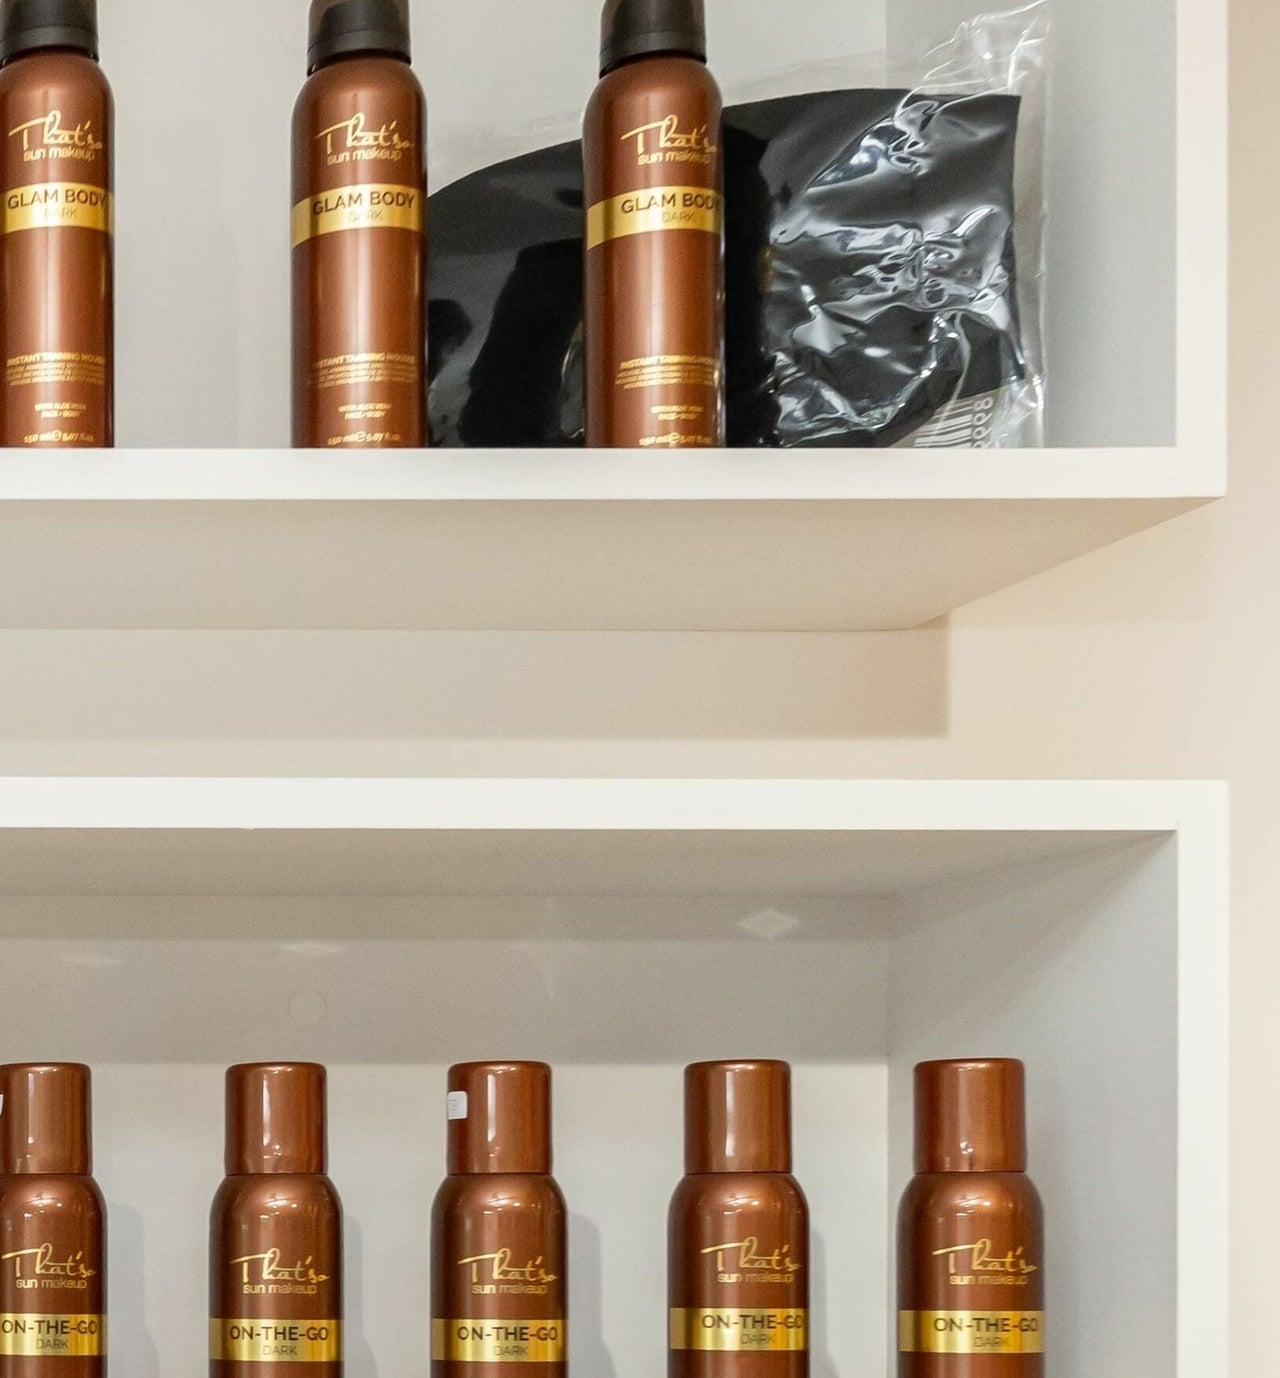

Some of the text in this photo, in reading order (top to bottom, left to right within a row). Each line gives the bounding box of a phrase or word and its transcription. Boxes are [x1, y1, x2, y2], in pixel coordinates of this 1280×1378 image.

[8, 189, 107, 210] GLAM BODY
[312, 193, 414, 215] GLAM BODY
[621, 193, 676, 214] GLAM
[16, 1278, 87, 1290] sun makeup
[243, 1282, 317, 1295] sun makeup
[472, 1284, 547, 1295] sun makeup
[2, 1320, 97, 1335] ON-THE-GO
[934, 1317, 1037, 1332] ON-THE-GO
[230, 1326, 328, 1341] ON-THE-GO
[457, 1326, 557, 1341] ON-THE-GO
[740, 1333, 772, 1344] DARK
[36, 1338, 69, 1349] DARK
[973, 1336, 1009, 1348] DARK
[263, 1345, 297, 1356] DARK
[493, 1346, 527, 1357] DARK
